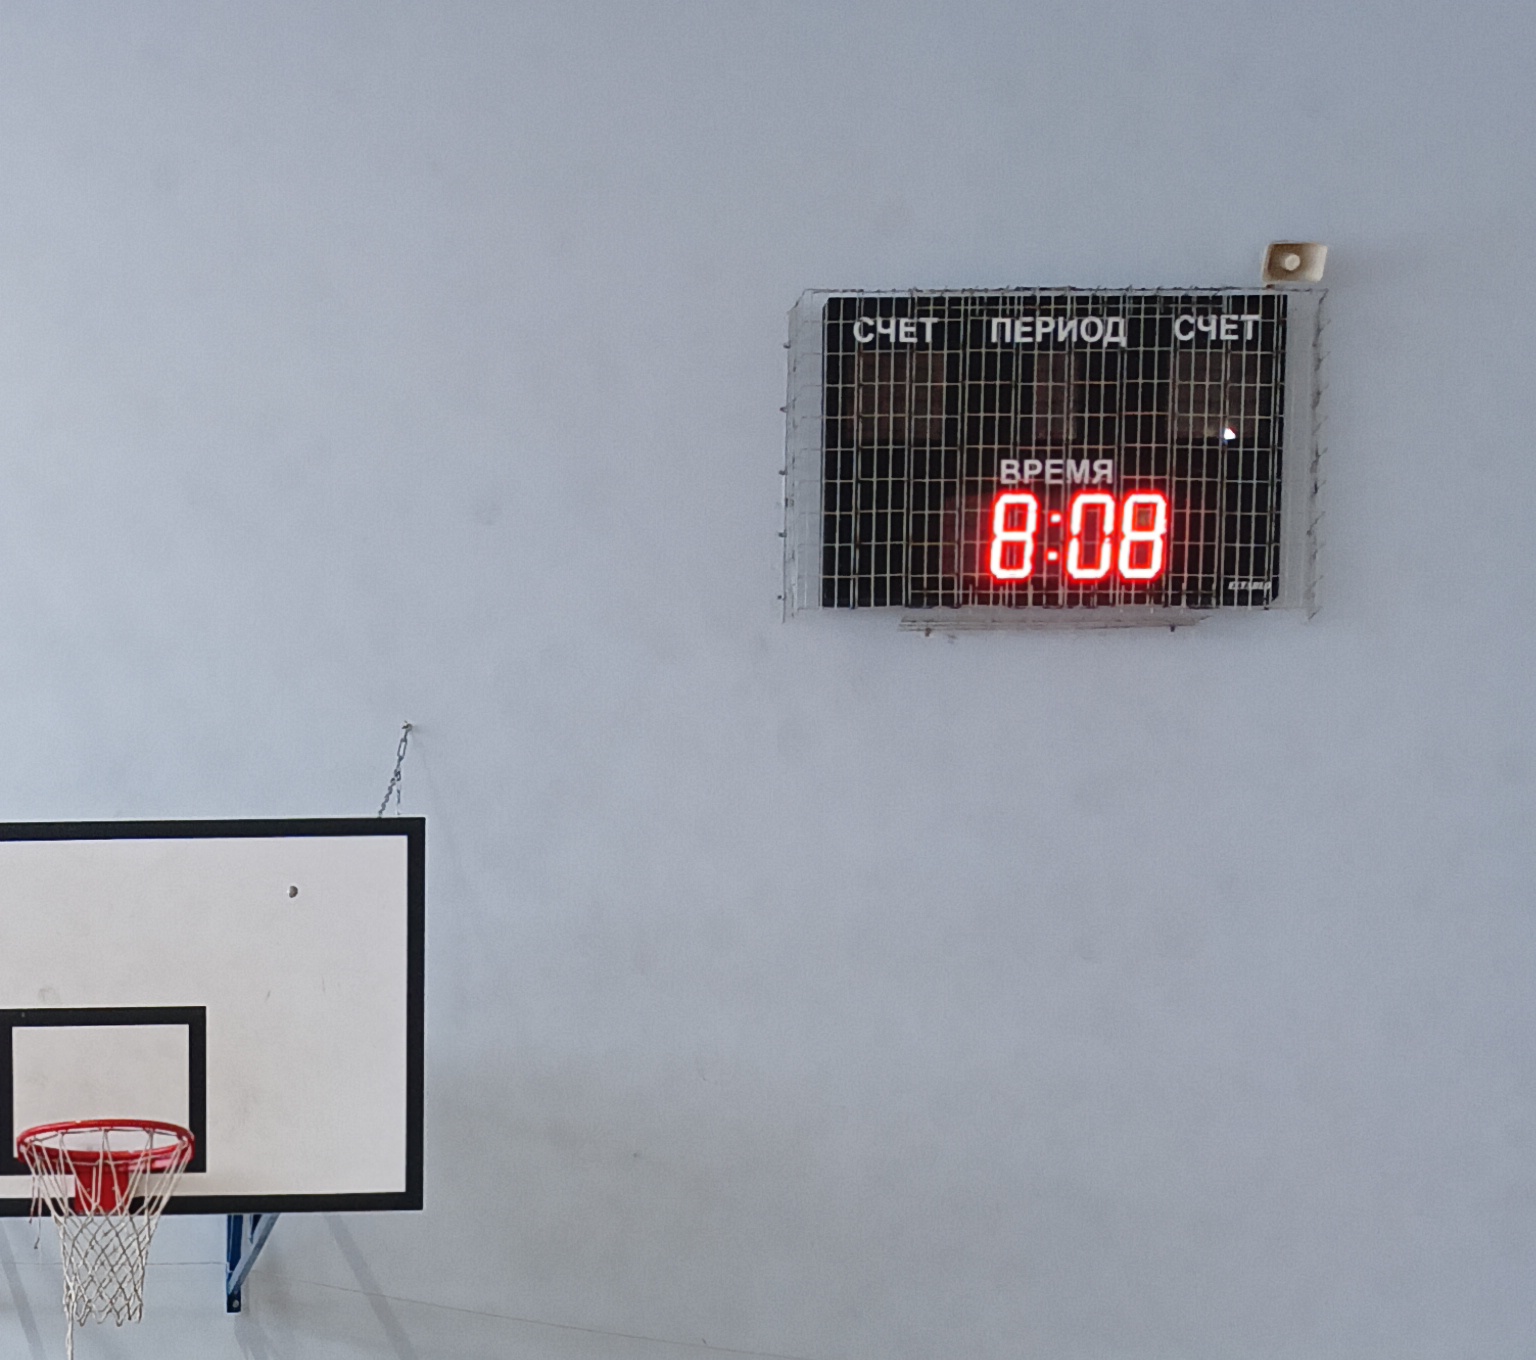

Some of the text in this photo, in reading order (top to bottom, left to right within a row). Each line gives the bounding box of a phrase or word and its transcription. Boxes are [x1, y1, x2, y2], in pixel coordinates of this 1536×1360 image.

[853, 314, 1260, 348] СЧЕТ ПЕРИОД СЧЕТ
[1000, 459, 1114, 485] ВРЕМЯ
[988, 491, 1170, 581] 8:08
